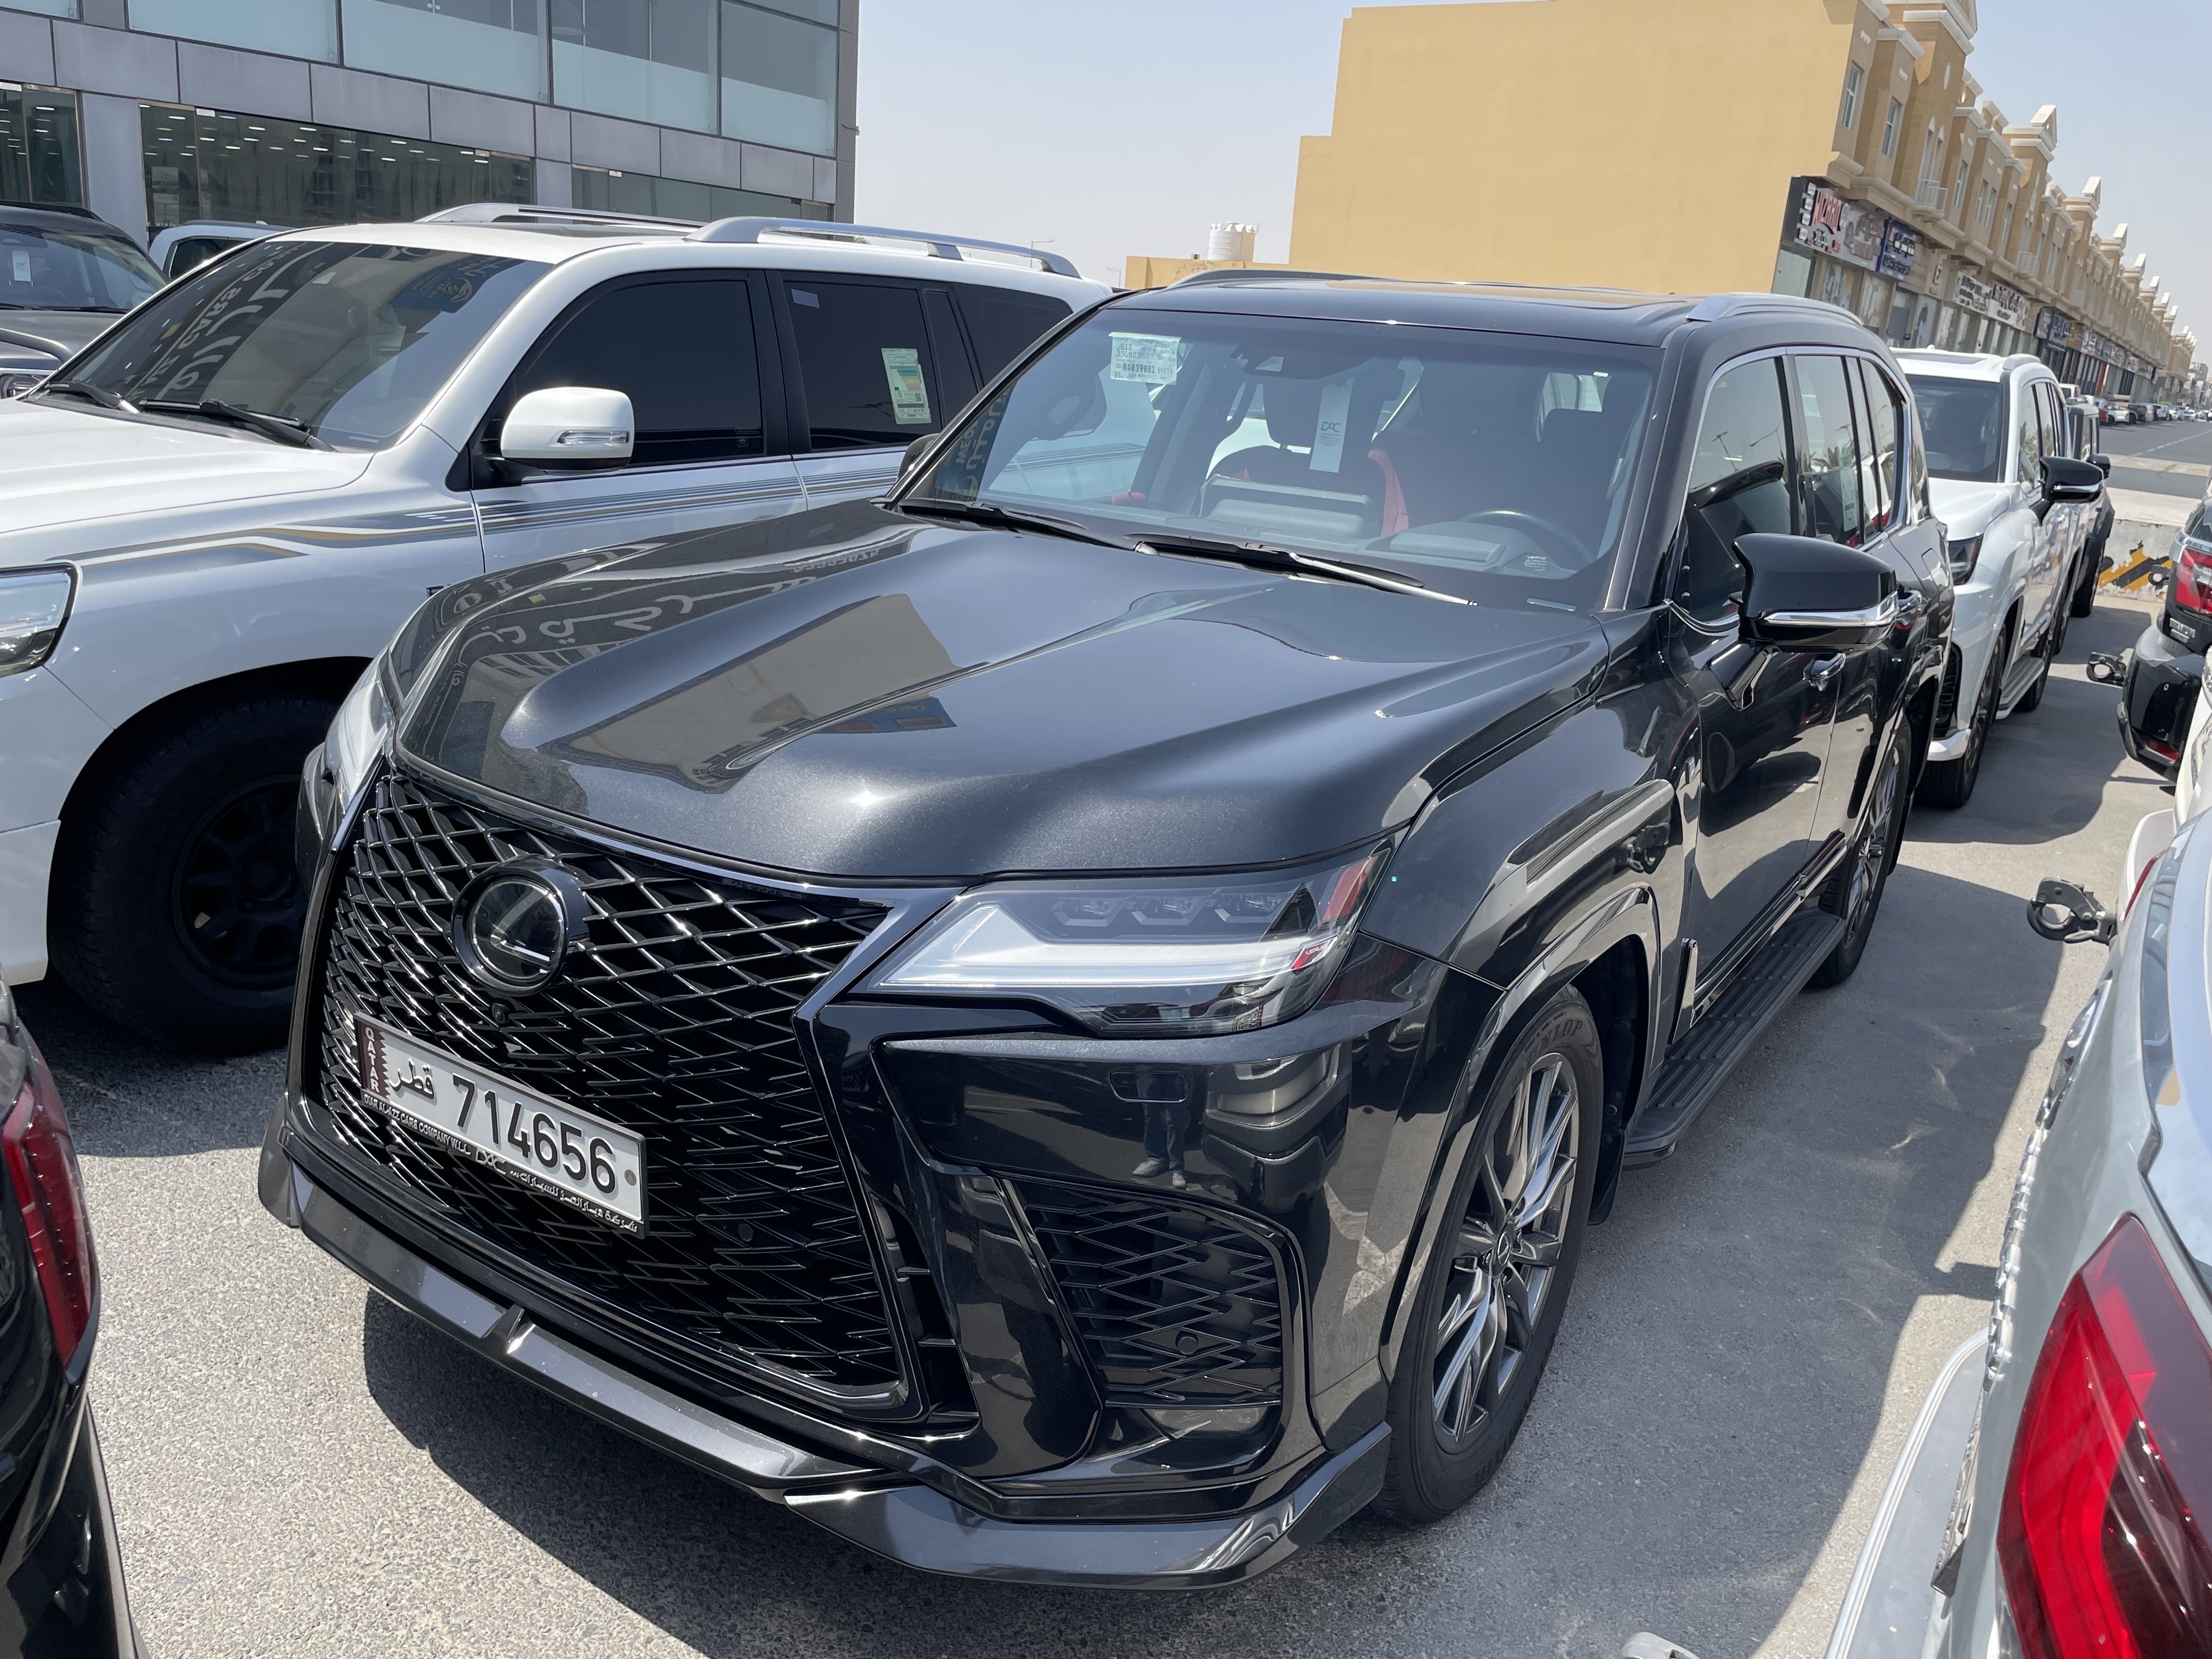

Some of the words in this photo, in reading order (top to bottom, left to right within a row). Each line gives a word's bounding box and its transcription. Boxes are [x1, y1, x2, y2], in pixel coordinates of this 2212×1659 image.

[365, 1027, 380, 1093] QATAR
[389, 1058, 435, 1099] قطر
[364, 1093, 379, 1110] DIAR
[400, 1113, 418, 1130] CARS
[419, 1122, 450, 1146] COMPANY
[452, 1073, 616, 1194] 714656
